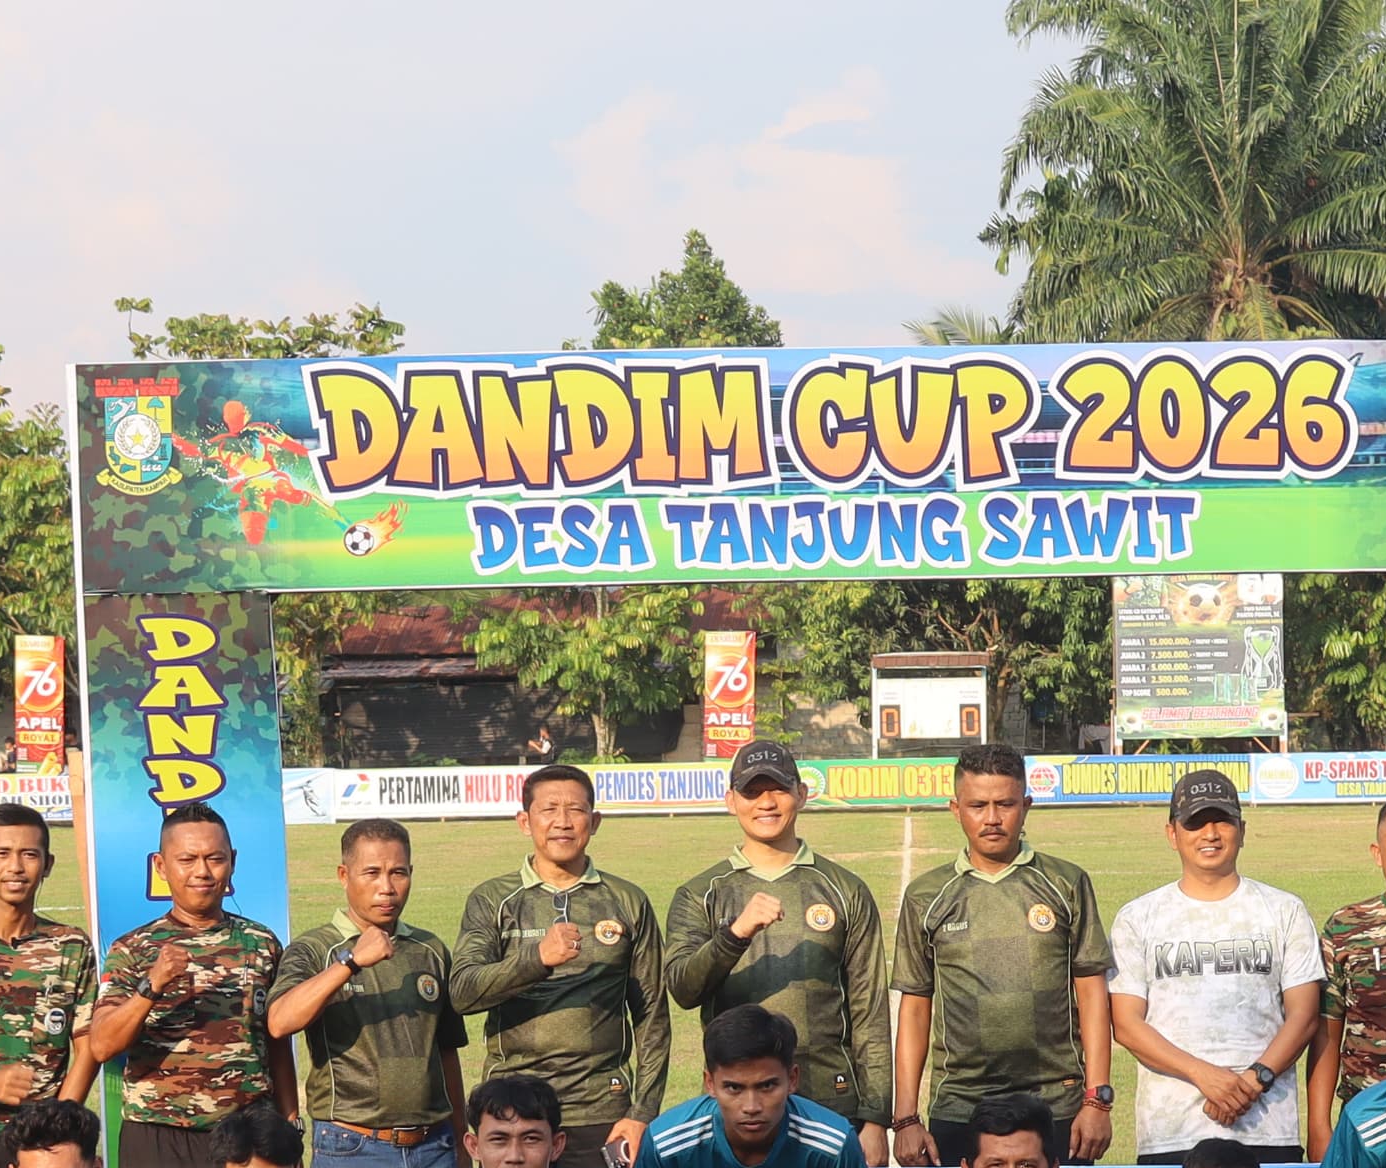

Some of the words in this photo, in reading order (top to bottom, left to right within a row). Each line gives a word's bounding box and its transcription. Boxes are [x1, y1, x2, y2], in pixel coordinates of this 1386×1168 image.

[306, 361, 775, 494] DANDIM
[788, 356, 1036, 486] CUP
[1057, 353, 1353, 475] 2026
[473, 503, 650, 569] DESA
[666, 499, 965, 567] TANJUNG
[984, 496, 1195, 561] SAWIT
[19, 661, 58, 705] 76
[709, 656, 749, 700] 76
[17, 717, 62, 731] APEL
[707, 713, 752, 725] APEL
[712, 729, 748, 739] ROYAL
[881, 708, 900, 737] 0
[961, 706, 979, 736] 0
[22, 732, 57, 742] ROYAL
[596, 771, 655, 801] PEMDES
[658, 769, 725, 799] TANJUNG
[827, 766, 902, 799] KODIM
[1062, 762, 1117, 795] BUMDES
[1118, 762, 1174, 794] BINTANG
[1305, 760, 1378, 780] KP-SPAMS
[379, 775, 461, 805] PERTAMINA
[464, 773, 502, 803] HULU
